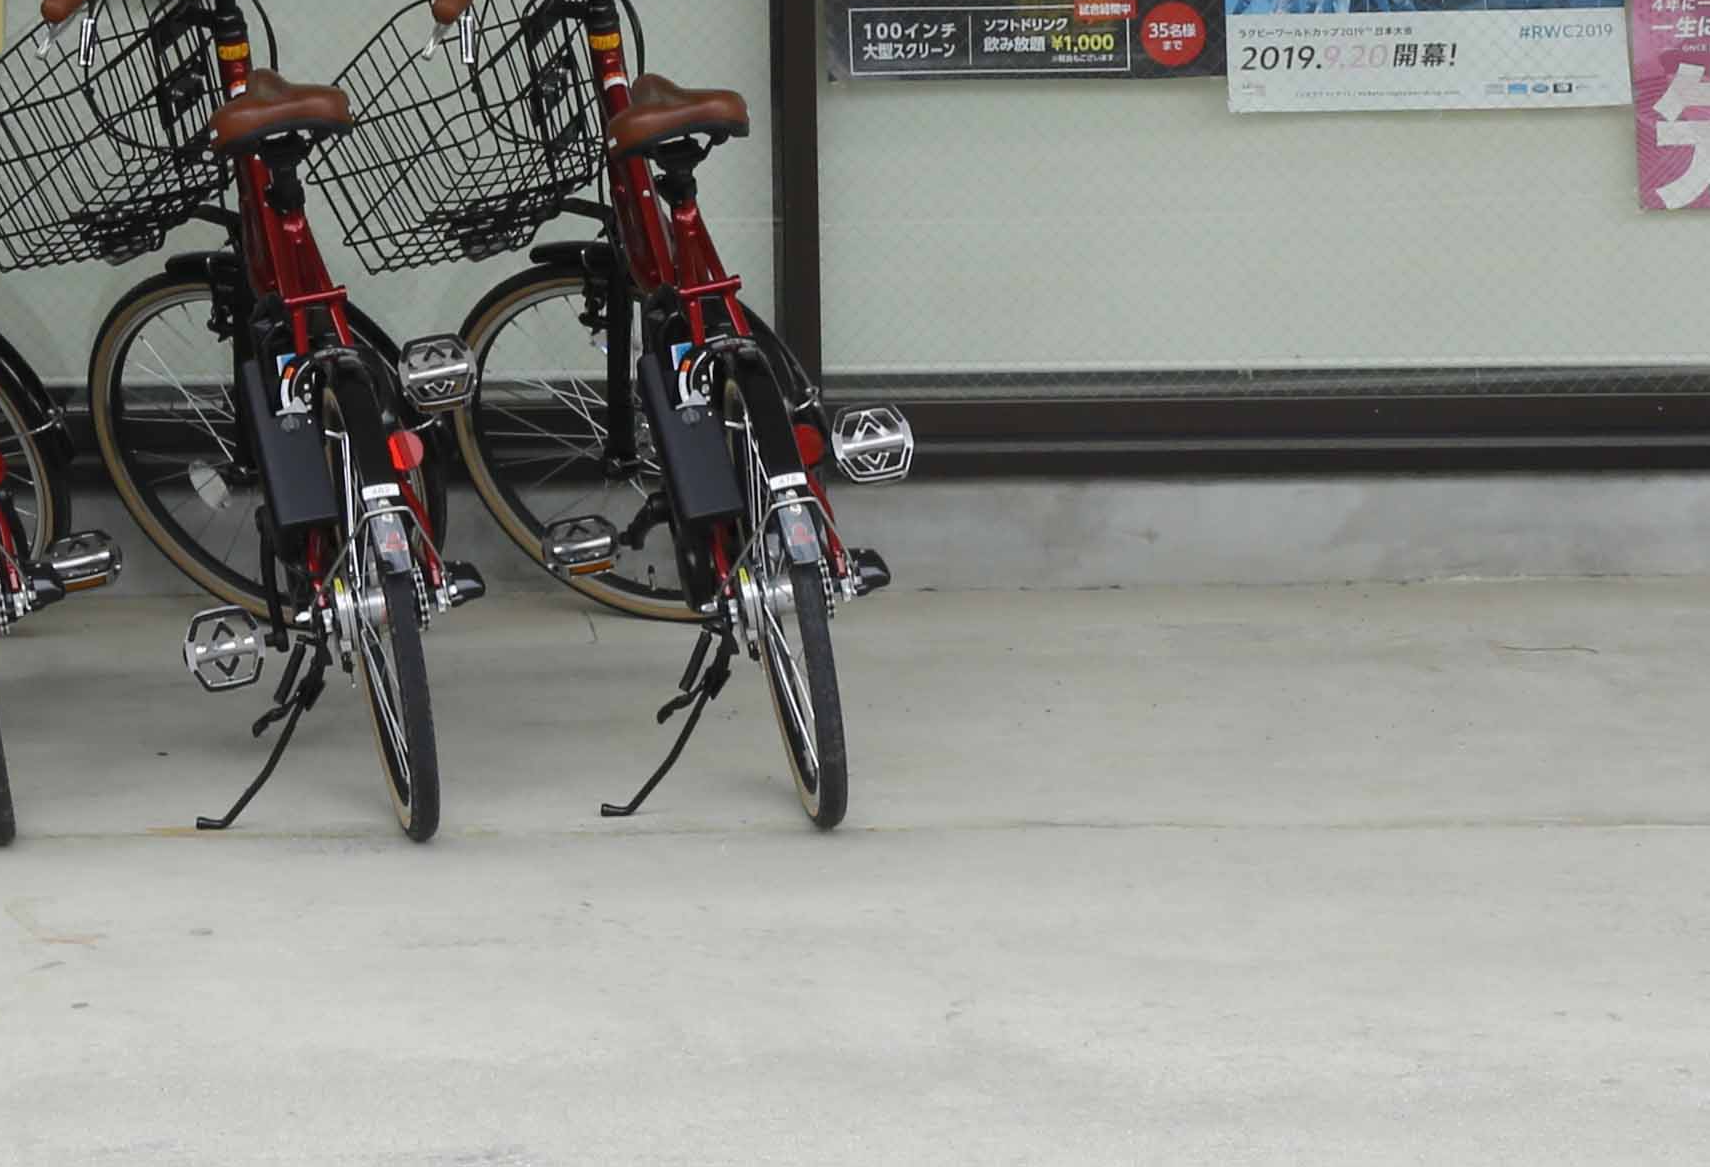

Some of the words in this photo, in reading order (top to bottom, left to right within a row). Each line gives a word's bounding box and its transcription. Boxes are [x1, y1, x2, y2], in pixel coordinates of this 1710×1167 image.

[863, 22, 957, 40] 100インチ
[984, 18, 1068, 32] ソフトドリンク
[1149, 23, 1197, 38] 35名様
[1520, 24, 1613, 39] #RWC2019
[983, 36, 1046, 53] 飲み放題
[1052, 33, 1115, 53] ¥1,000
[1162, 40, 1183, 51] まで
[863, 42, 956, 60] 大型スクリーン
